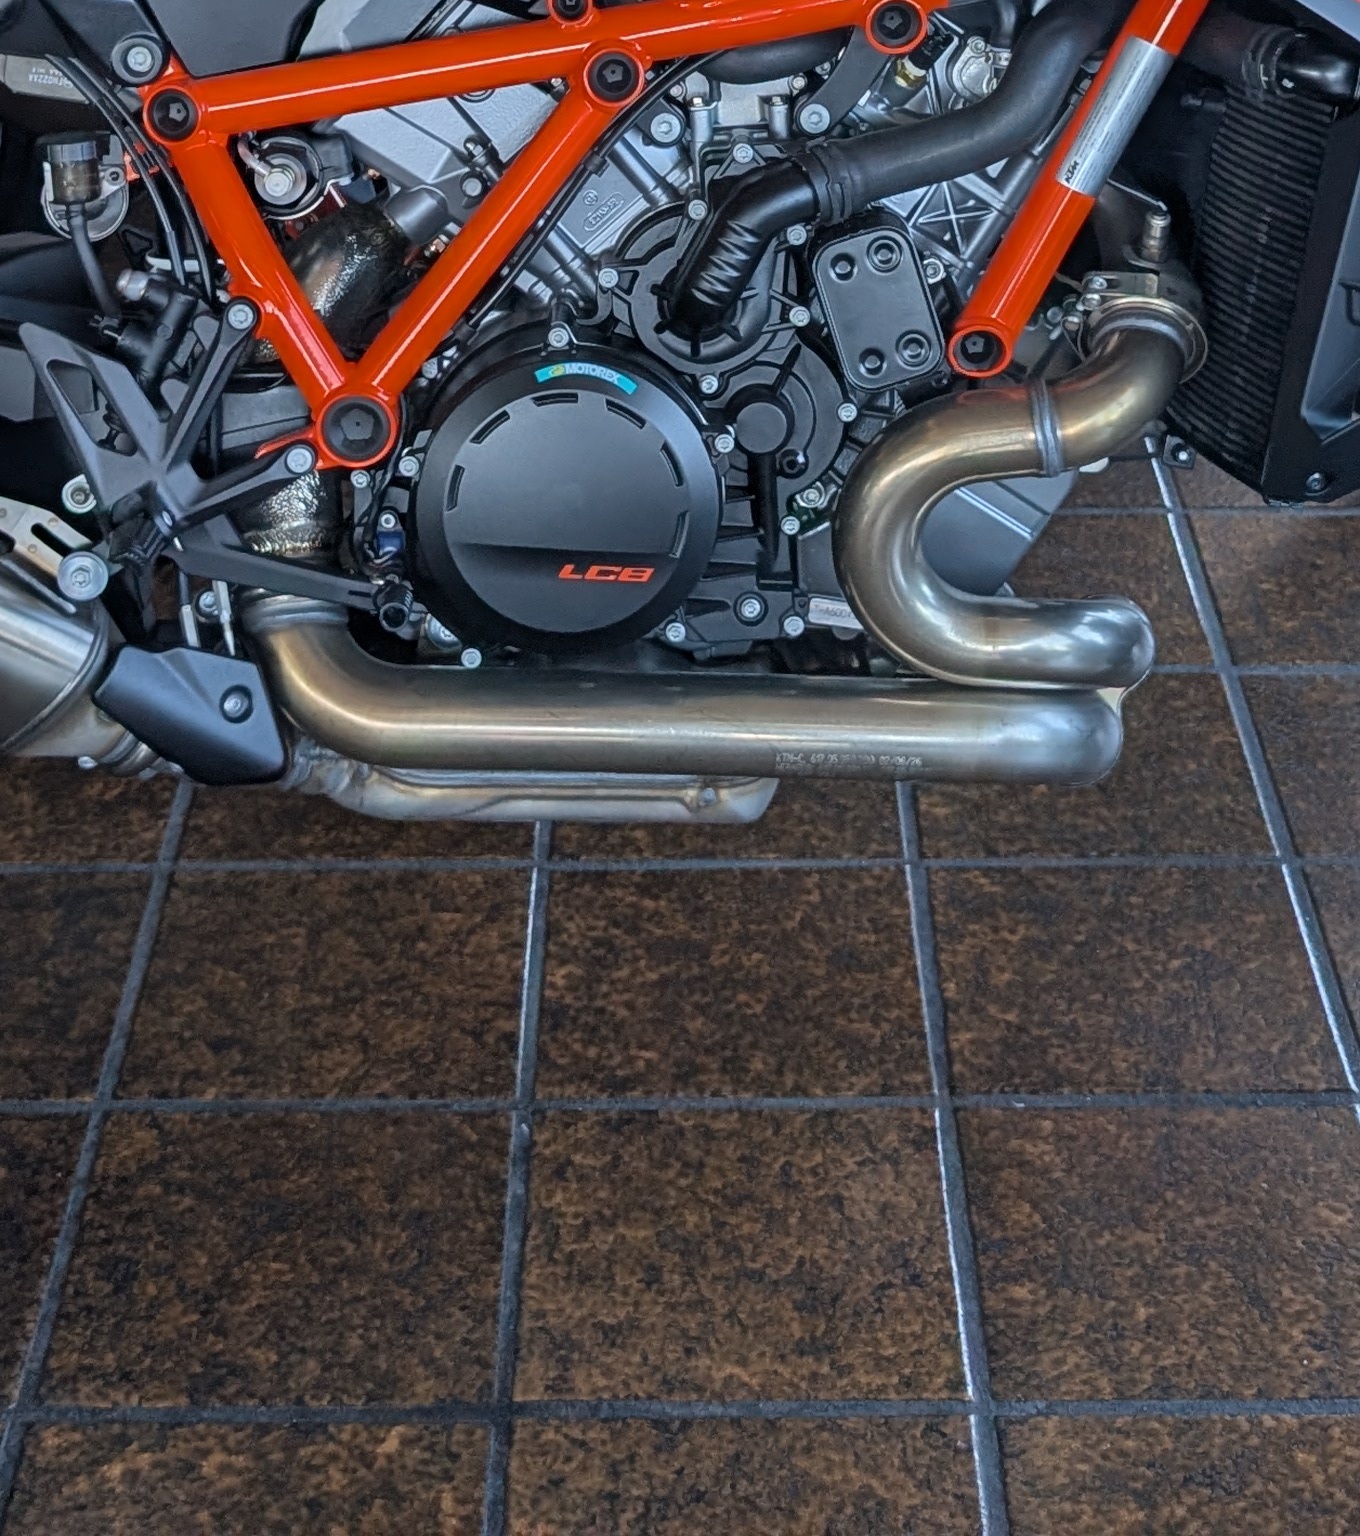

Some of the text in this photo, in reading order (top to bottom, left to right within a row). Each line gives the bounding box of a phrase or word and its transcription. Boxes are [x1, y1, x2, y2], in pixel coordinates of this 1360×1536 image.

[1064, 159, 1080, 184] KTM
[564, 362, 621, 384] MOTOREX
[558, 563, 656, 583] LC8
